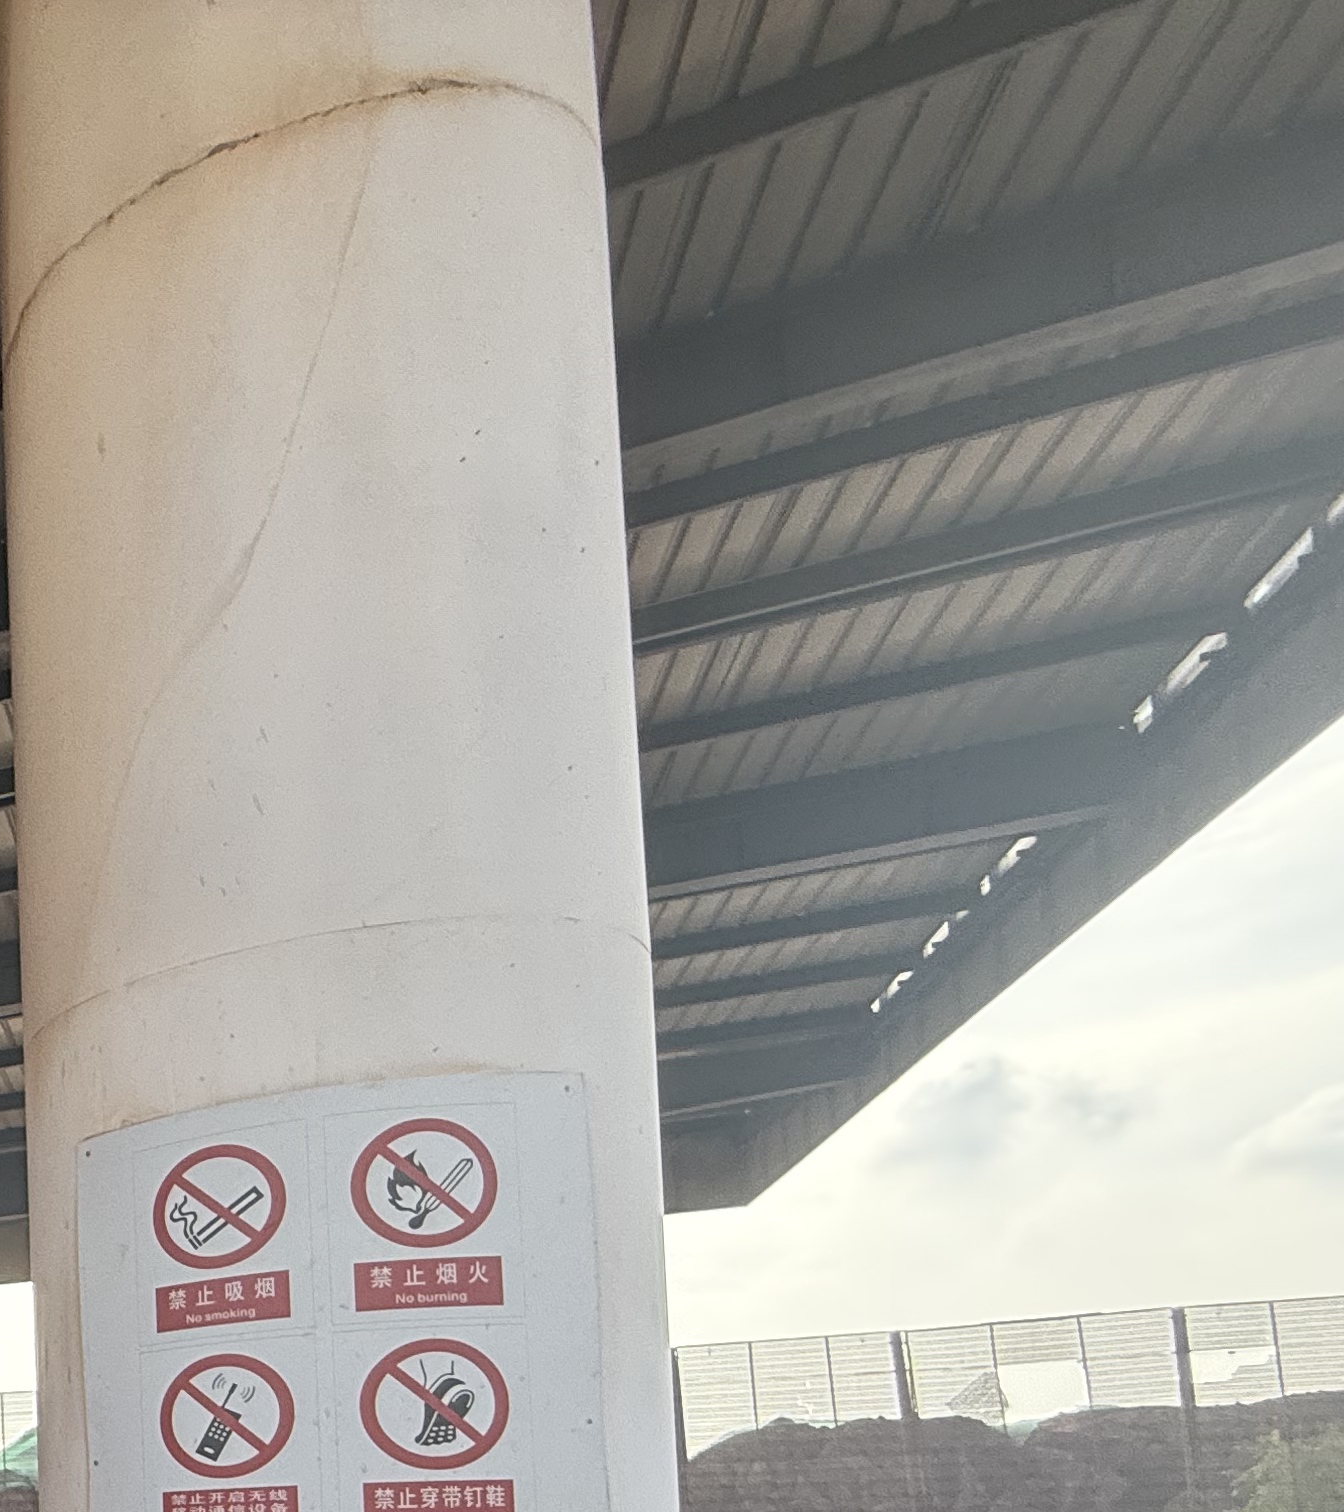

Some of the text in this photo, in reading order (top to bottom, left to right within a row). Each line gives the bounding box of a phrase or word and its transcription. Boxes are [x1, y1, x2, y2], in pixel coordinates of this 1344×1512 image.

[370, 1261, 489, 1288] 禁止烟火
[168, 1277, 275, 1310] 禁止吸烟
[395, 1292, 468, 1304] No burning
[186, 1308, 256, 1325] No smoking
[171, 1489, 288, 1506] 禁止开启无线
[374, 1485, 506, 1509] 禁止穿带钉鞋
